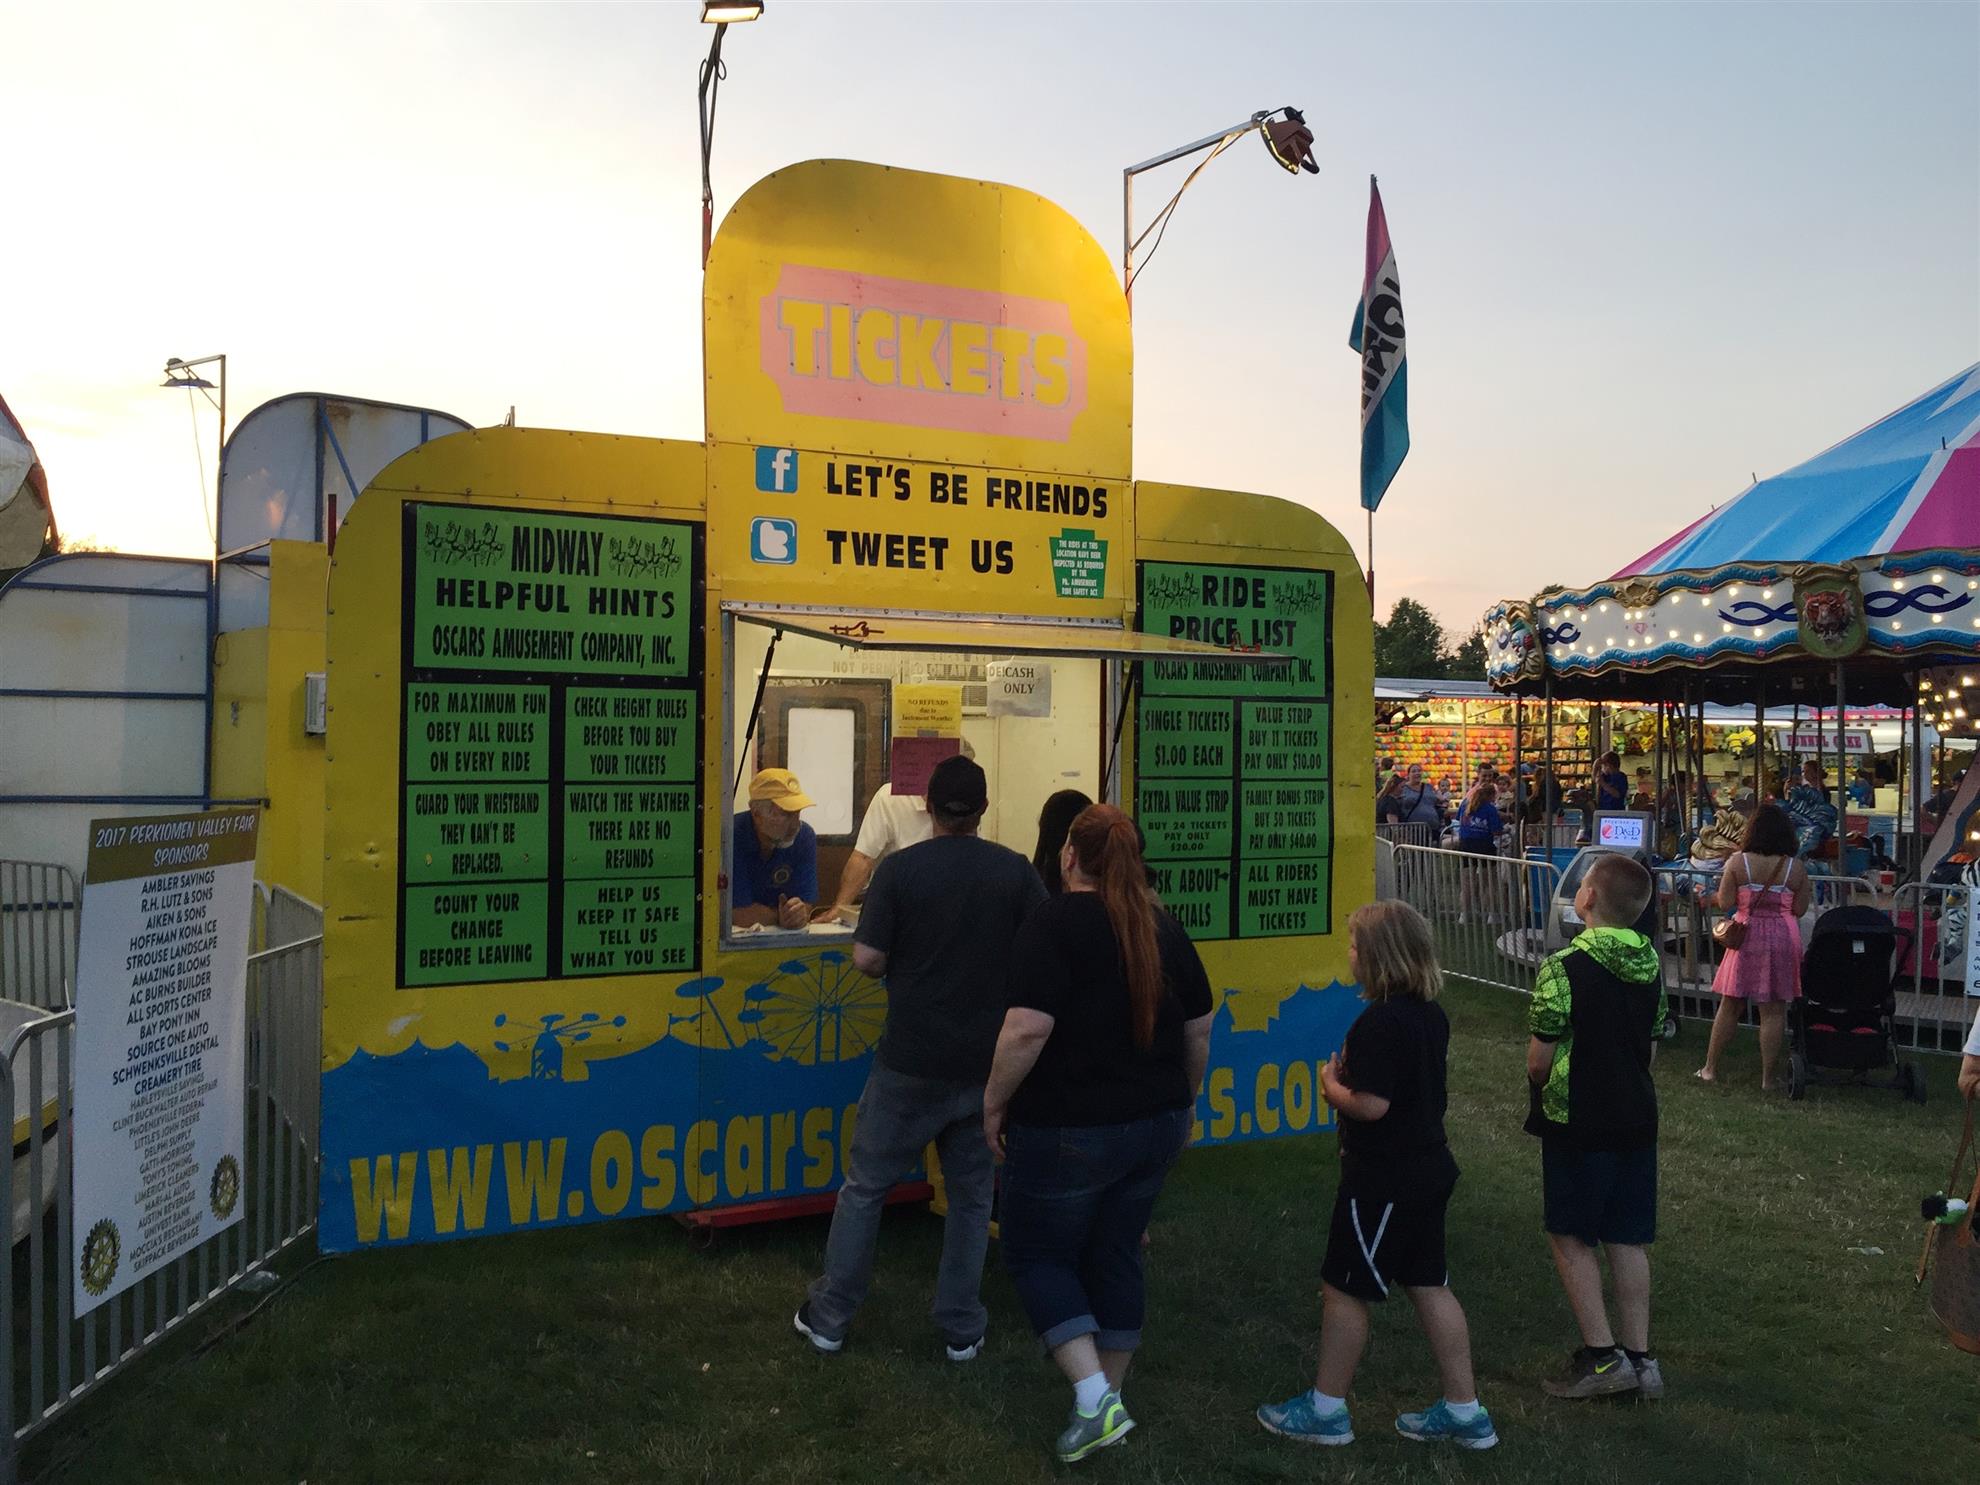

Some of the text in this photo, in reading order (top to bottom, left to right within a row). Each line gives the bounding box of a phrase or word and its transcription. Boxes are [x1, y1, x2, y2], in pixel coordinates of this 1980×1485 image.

[777, 295, 1073, 410] TICKETS
[827, 463, 1108, 518] LET'S BE FRIENDS
[511, 526, 604, 576] MIDWAY
[826, 530, 1013, 574] TWEET US
[436, 578, 675, 619] HELPFUL HINTS
[1202, 575, 1266, 608] RIDE
[1170, 616, 1296, 647] PRICE LIST
[432, 625, 675, 668] OSCARS AMUSEMENT COMPANY, INC.
[1005, 667, 1034, 678] CASH
[1299, 659, 1315, 683] INC.
[1004, 683, 1035, 694] ONLY
[415, 692, 546, 713] FOR MAXIMUM FUN
[575, 697, 687, 719] CHECK HEIGHT RULES
[1145, 711, 1230, 732] SINGLE TICKETS
[1256, 707, 1312, 724] VALUE STRIP
[427, 722, 534, 742] OBEY ALL RULES
[584, 725, 677, 746] BEFORE YOU BUY
[1249, 730, 1267, 746] BUY
[1284, 730, 1318, 746] TICKETS
[1833, 736, 1862, 748] CKE
[431, 751, 530, 771] ON EVERY RIDE
[591, 755, 666, 774] YOUR TICKETS
[1155, 745, 1224, 768] $1.00 EACH
[1245, 754, 1321, 771] PAY ONLY $10.00
[416, 793, 539, 814] GUARD YOUR WRISTBAND
[570, 792, 690, 812] WATCH THE WEATHER
[1143, 790, 1229, 813] EXTRA VALUE STRIP
[1246, 790, 1324, 805] FAMILY BONUS STRIP
[1148, 822, 1169, 830] BUY
[1255, 812, 1269, 827] BUY
[1287, 812, 1316, 826] TICKETS
[95, 815, 255, 848] 2017 PERKIOMEN VALLEY FAIR
[441, 824, 465, 844] THEY
[503, 823, 515, 843] BE
[589, 821, 670, 841] THERE ARE NO
[1165, 832, 1209, 840] PAY ONLY
[1250, 834, 1316, 849] PAY ONLY $40.00
[154, 843, 209, 867] SPONSORS
[1171, 842, 1204, 851] $20.00
[452, 853, 503, 874] REPLACED.
[606, 849, 653, 869] REFUNDS
[141, 871, 215, 894] AMBLER SAVINGS
[1156, 868, 1220, 892] SK ABOUT
[1249, 864, 1318, 882] ALL RIDERS
[141, 887, 213, 912] R.H. LUTZ & SONS
[435, 894, 519, 914] COUNT YOUR
[598, 887, 660, 903] HELP US
[1248, 888, 1317, 906] MUST HAVE
[146, 906, 206, 930] AIKEN & SONS
[578, 906, 679, 924] KEEP IT SAFE
[1259, 912, 1306, 930] TICKETS
[130, 920, 217, 951] HOFFMAN KONA ICE
[451, 921, 503, 939] CHANGE
[599, 928, 657, 945] TELL US
[126, 936, 218, 971] STROUSE LANDSCAPE
[419, 944, 532, 969] BEFORE LEAVING
[570, 948, 685, 968] WHAT YOU SEE
[132, 955, 211, 987] AMAZING BLOOMS
[129, 972, 211, 1007] AC BURNS BUILDER
[127, 988, 211, 1026] ALL SPORTS CENTER
[140, 1009, 200, 1039] BAY PONY INN
[128, 1022, 209, 1062] SOURCE ONE AUTO
[112, 1037, 219, 1086] SCHWENKSVILLE DENTAL
[134, 1058, 202, 1096] CREAMERY TIRE
